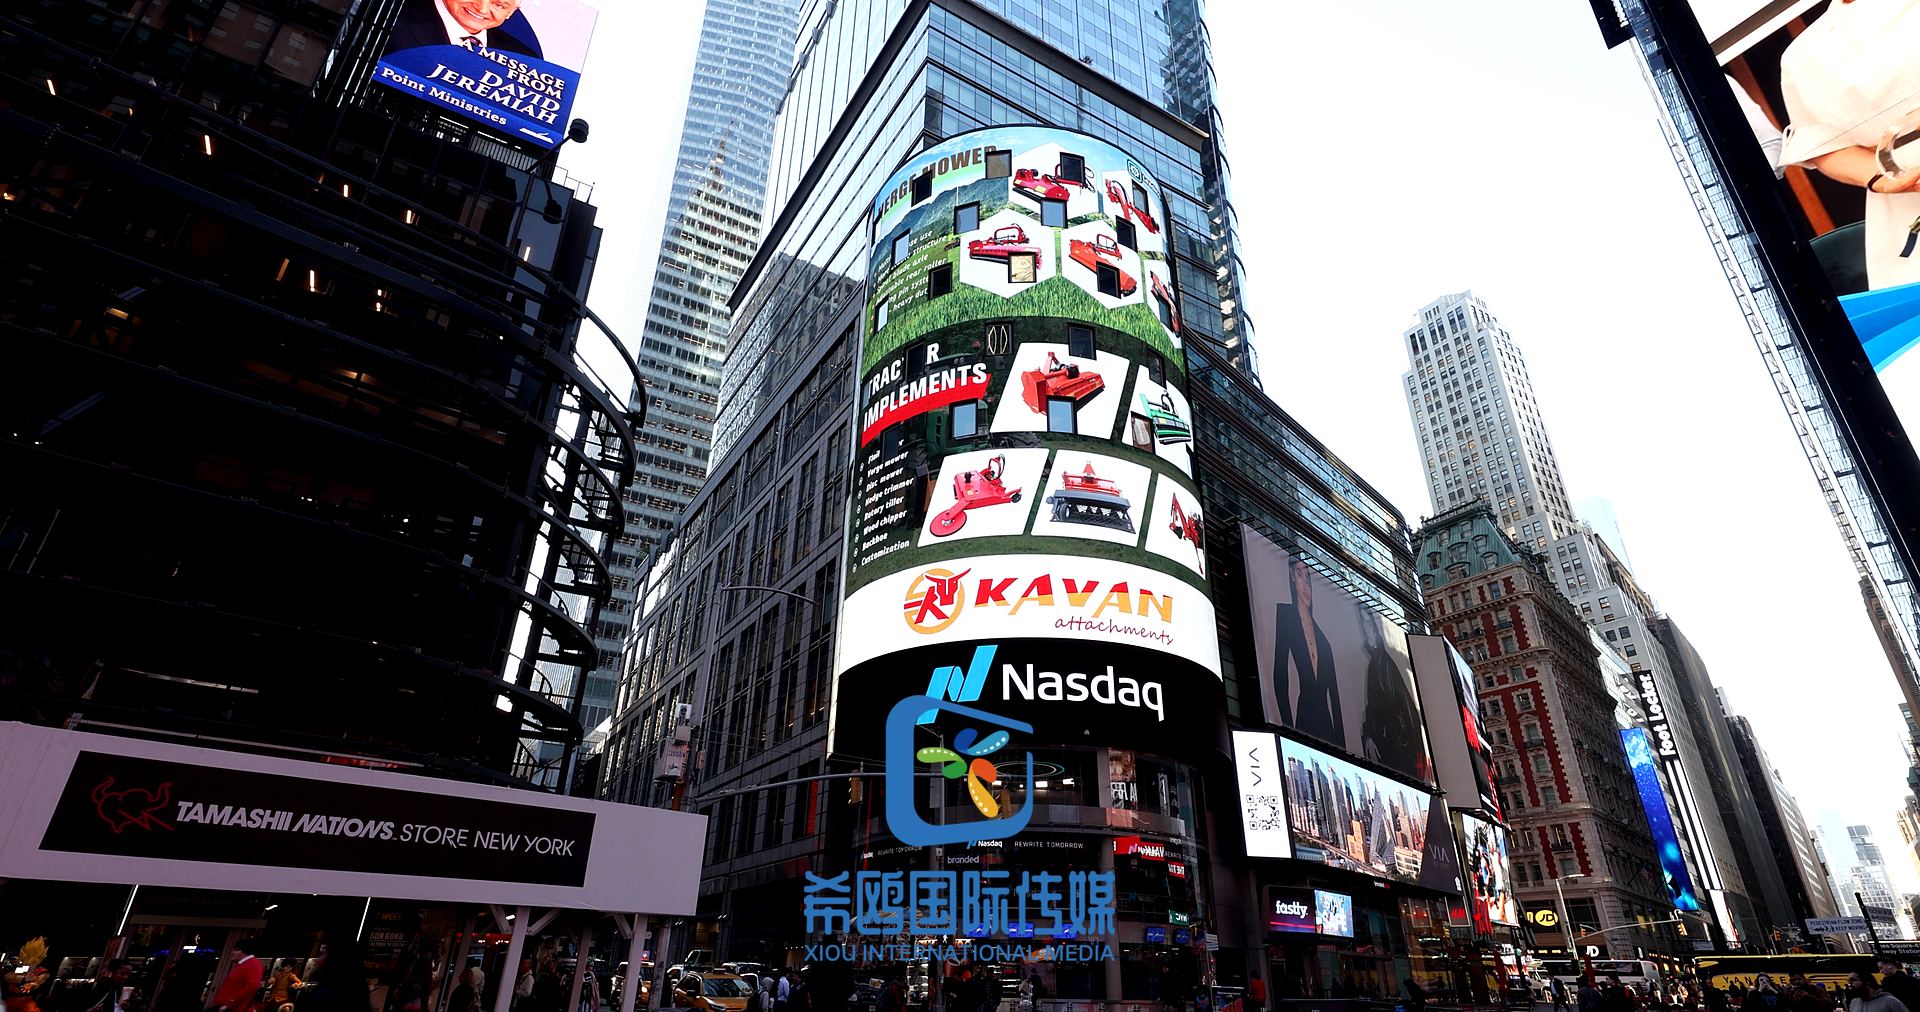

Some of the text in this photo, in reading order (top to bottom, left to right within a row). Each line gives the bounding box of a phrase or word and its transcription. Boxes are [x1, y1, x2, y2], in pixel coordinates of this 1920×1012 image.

[459, 39, 565, 90] A MESSAGE
[381, 67, 507, 125] Point Ministries
[426, 63, 558, 125] JEREMIAH
[478, 70, 561, 112] DAVID
[507, 69, 562, 100] FROM
[913, 235, 947, 256] structure
[924, 257, 947, 271] roller
[863, 362, 988, 432] IMPLEMENTS
[884, 451, 909, 468] mower
[880, 467, 904, 484] mower
[884, 477, 915, 495] trimmer
[885, 496, 905, 509] tiller
[880, 509, 908, 527] chipper
[861, 540, 910, 566] Customization
[862, 532, 888, 552] Backhoe
[975, 573, 1173, 624] KAVAN
[1055, 616, 1174, 645] attachments
[1002, 663, 1165, 722] Nasdaq
[1639, 673, 1665, 722] Locker
[176, 801, 292, 831] TAMASHII
[399, 824, 469, 849] STORE
[474, 828, 521, 851] NEW
[523, 834, 574, 858] YORK
[978, 840, 1003, 849] Nasdaq
[1046, 841, 1084, 849] TOMORROW
[947, 855, 980, 865] branded
[1723, 976, 1787, 985] YANEE
